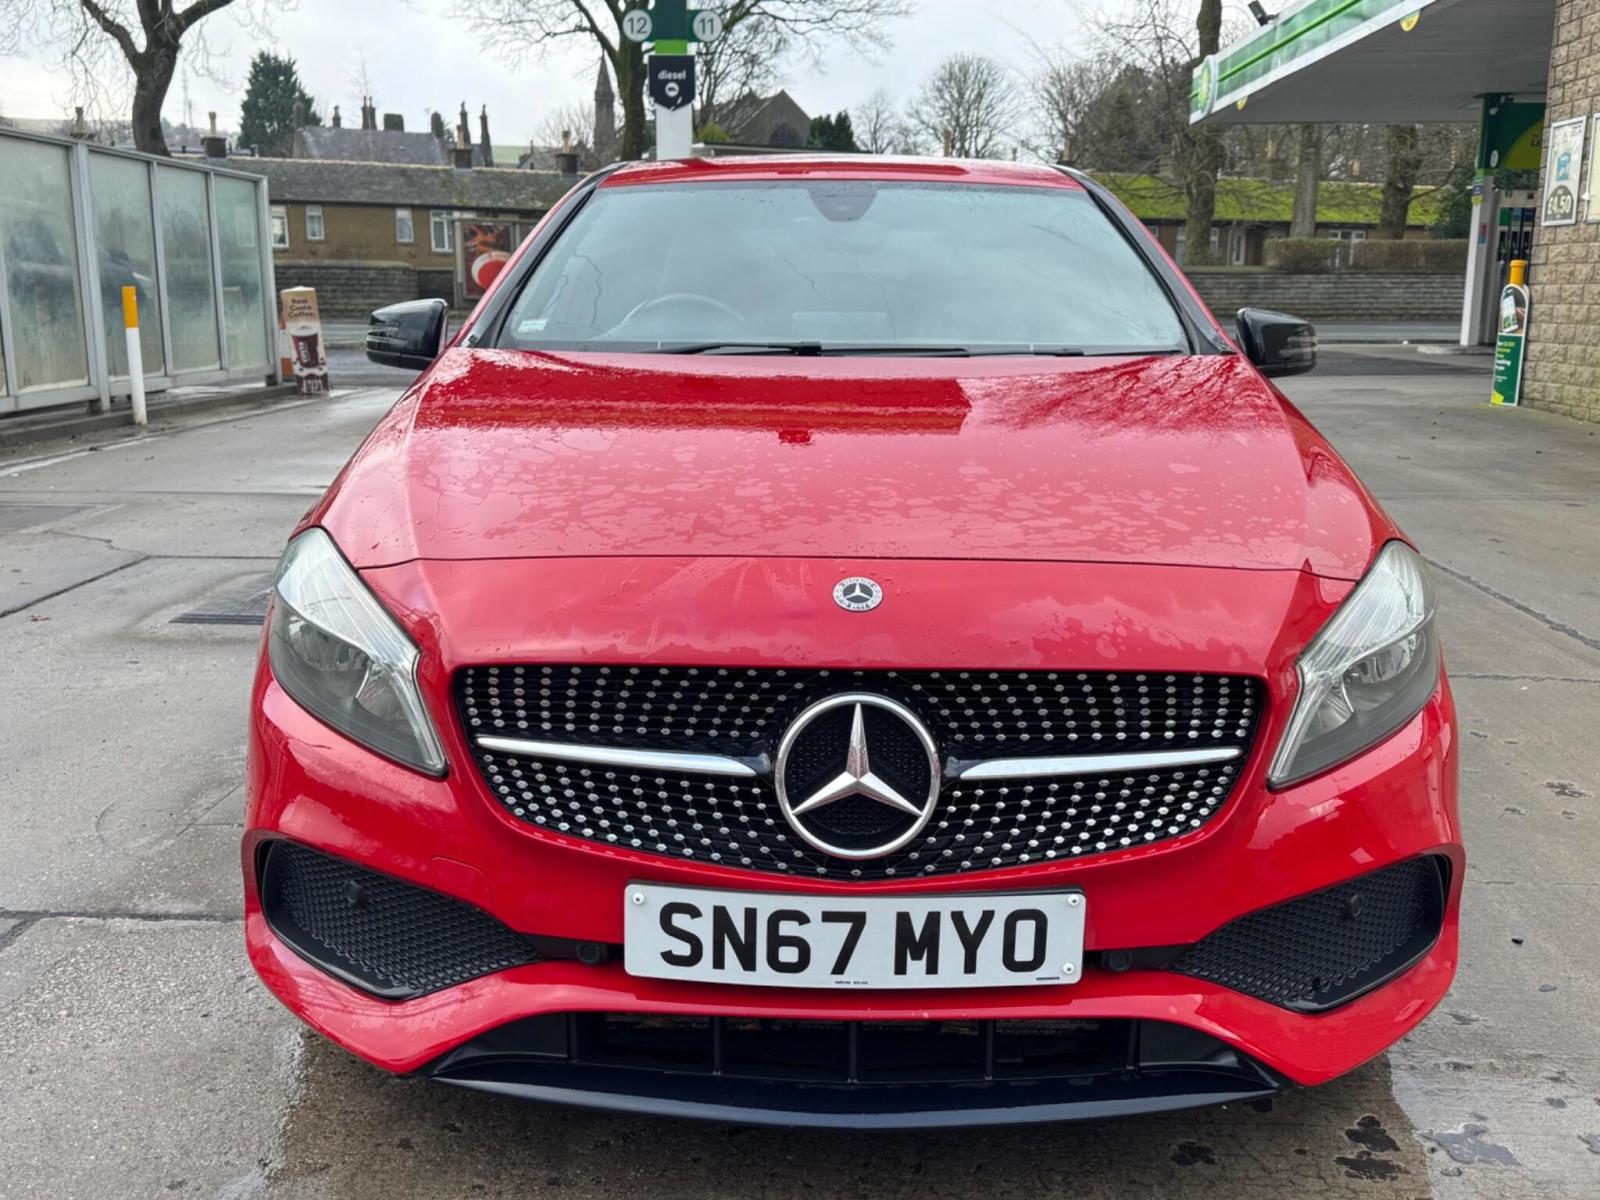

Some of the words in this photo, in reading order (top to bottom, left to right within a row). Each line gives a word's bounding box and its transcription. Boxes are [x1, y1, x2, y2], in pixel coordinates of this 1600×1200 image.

[627, 16, 648, 34] 12
[699, 18, 715, 34] 11
[657, 69, 687, 80] diesel
[1547, 194, 1573, 215] £4.50
[659, 901, 867, 976] SN67
[893, 908, 1048, 976] MYO
